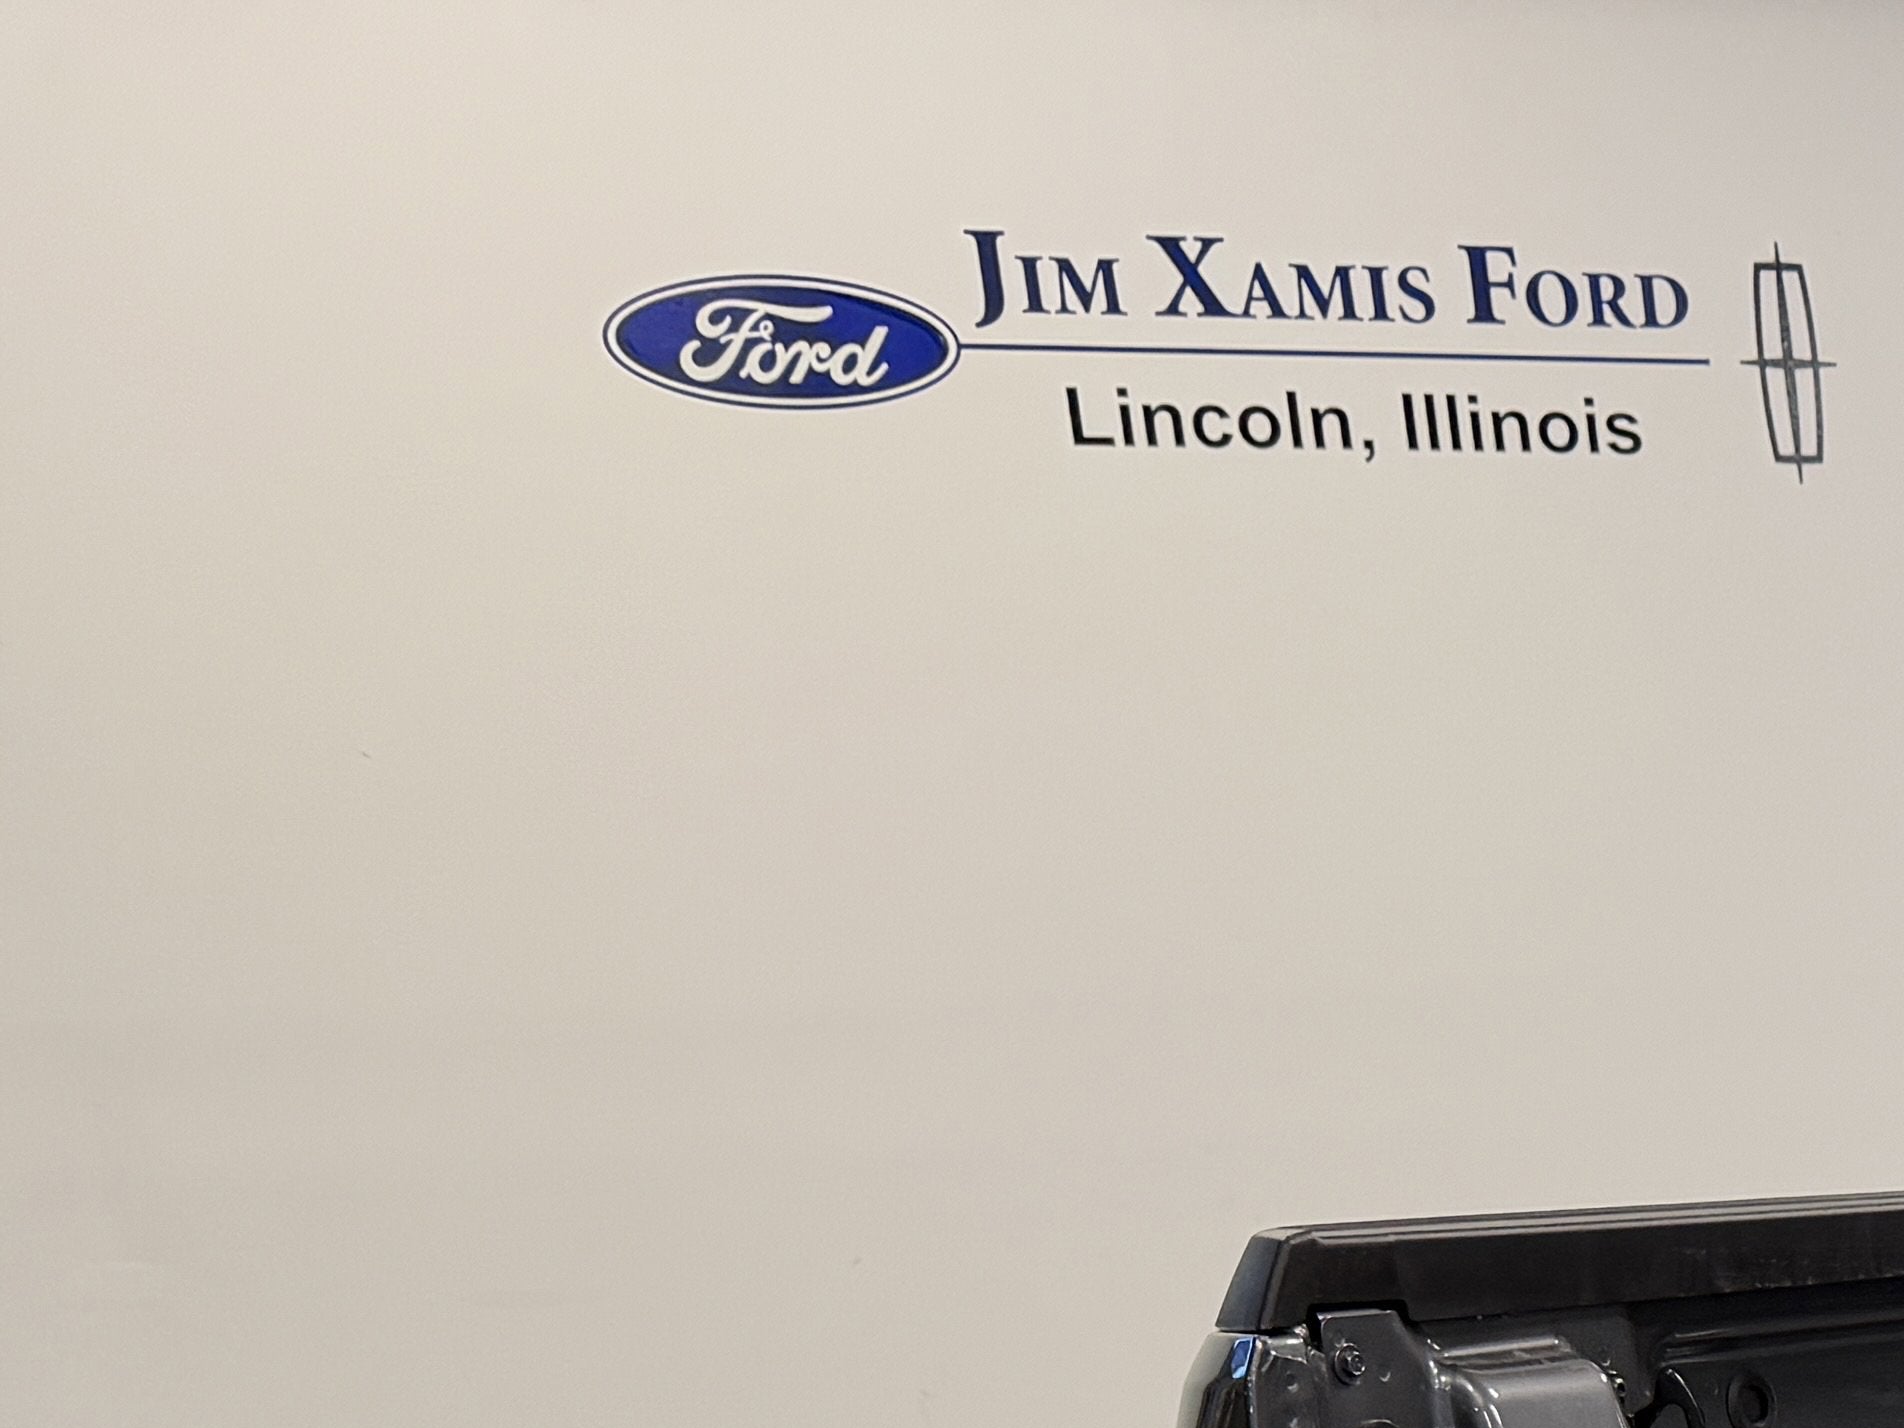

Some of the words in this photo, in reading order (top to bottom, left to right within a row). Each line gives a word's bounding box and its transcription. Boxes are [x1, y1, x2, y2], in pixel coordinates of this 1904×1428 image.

[963, 229, 1128, 328] JIM
[1146, 235, 1435, 324] XAMIS
[1457, 245, 1688, 329] FORD
[680, 299, 888, 386] Ford
[1066, 387, 1375, 463] Lincoln,
[1402, 393, 1642, 455] Illinois
